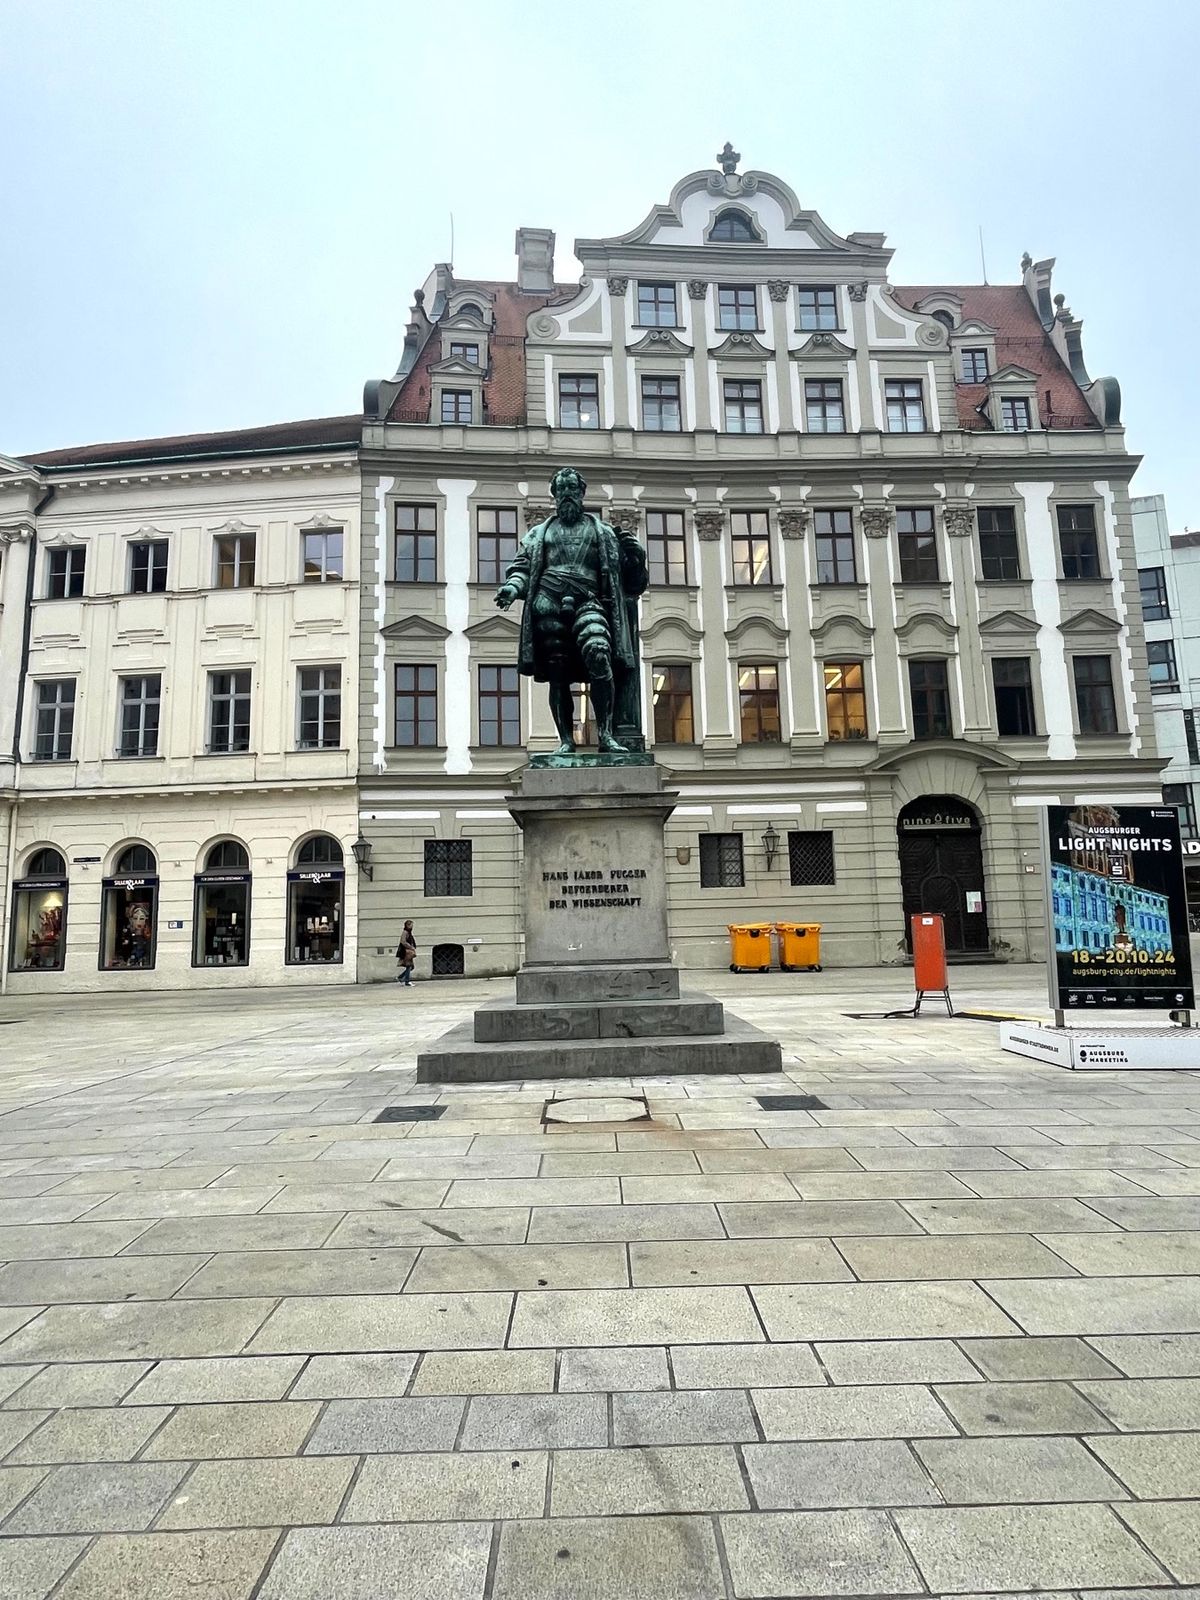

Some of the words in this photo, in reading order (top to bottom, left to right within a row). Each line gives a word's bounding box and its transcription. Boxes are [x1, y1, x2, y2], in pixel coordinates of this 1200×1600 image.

[946, 815, 970, 824] five
[1088, 826, 1141, 835] AUGSBURGER
[1058, 837, 1107, 851] LIGHT
[1111, 838, 1173, 852] NIGHTS
[542, 871, 569, 881] HANS
[610, 869, 647, 880] FUGGER
[561, 884, 629, 895] BEFOERDERER
[549, 899, 568, 909] DER
[572, 897, 642, 908] WISSENSCHAFT
[1072, 966, 1177, 977] augsburg-city.de/lightnights
